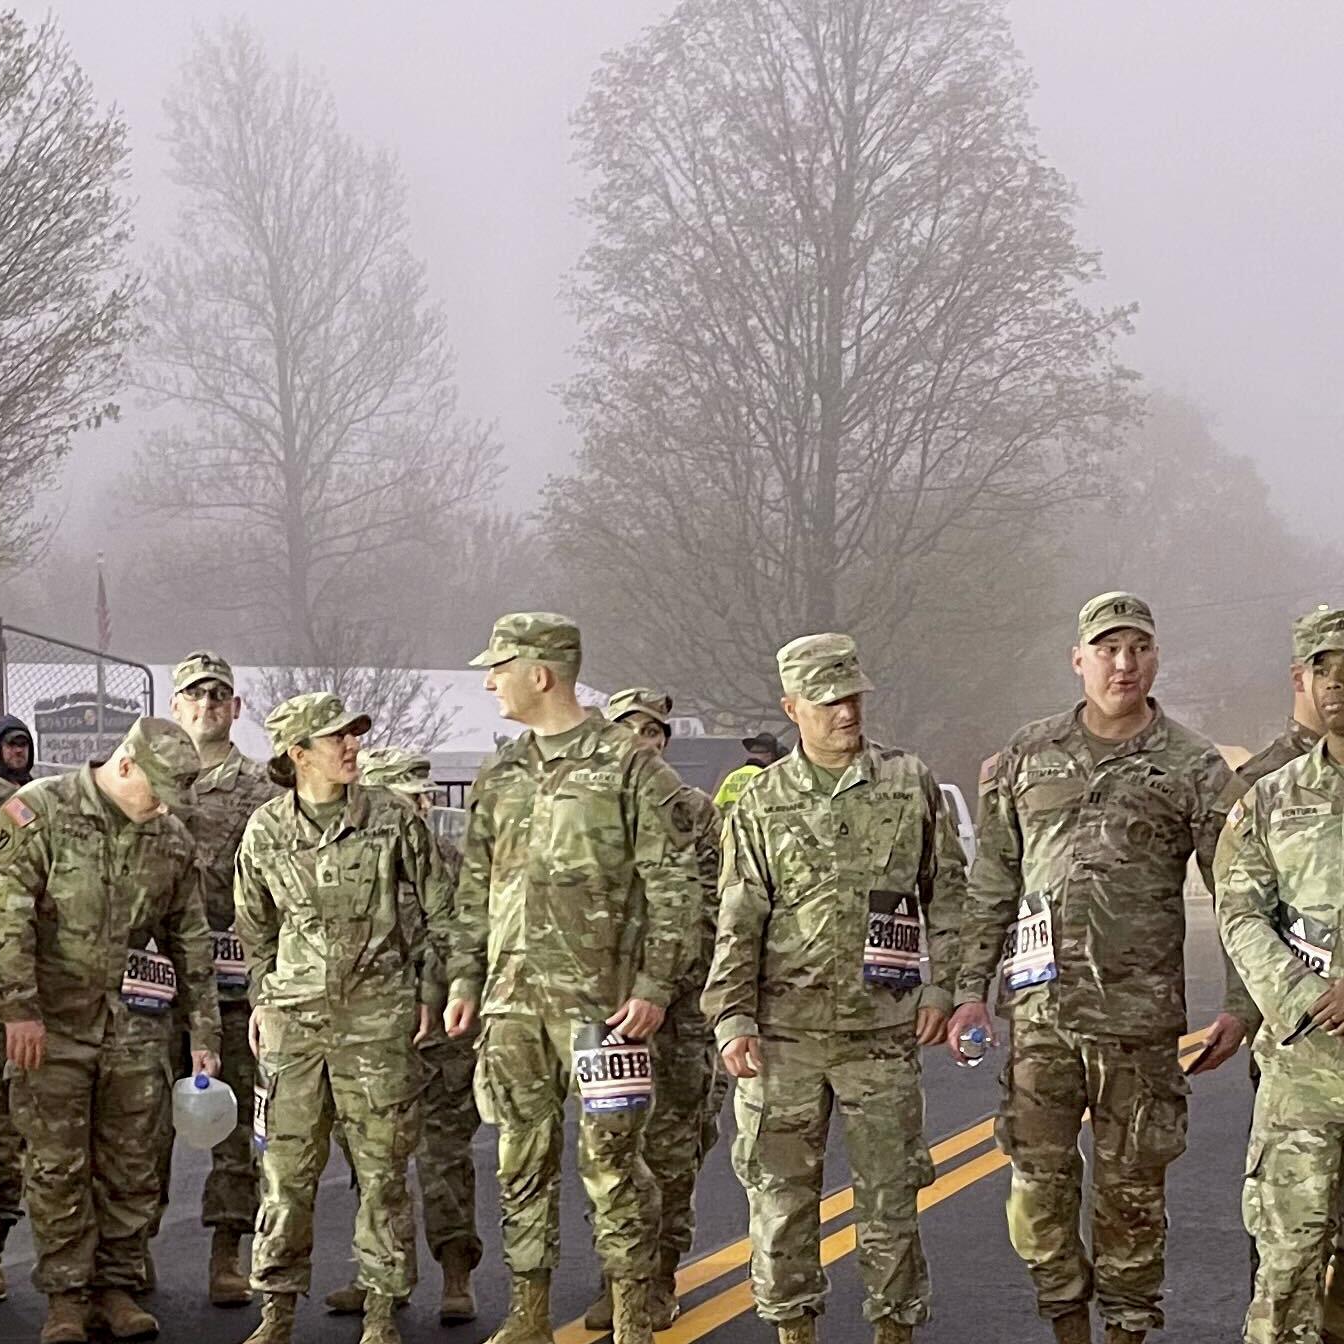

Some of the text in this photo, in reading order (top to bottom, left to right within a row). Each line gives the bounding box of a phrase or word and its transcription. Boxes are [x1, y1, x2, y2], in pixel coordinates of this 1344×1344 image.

[1282, 807, 1318, 818] VENTURA
[127, 954, 176, 987] 33005
[577, 1052, 649, 1083] 33018
